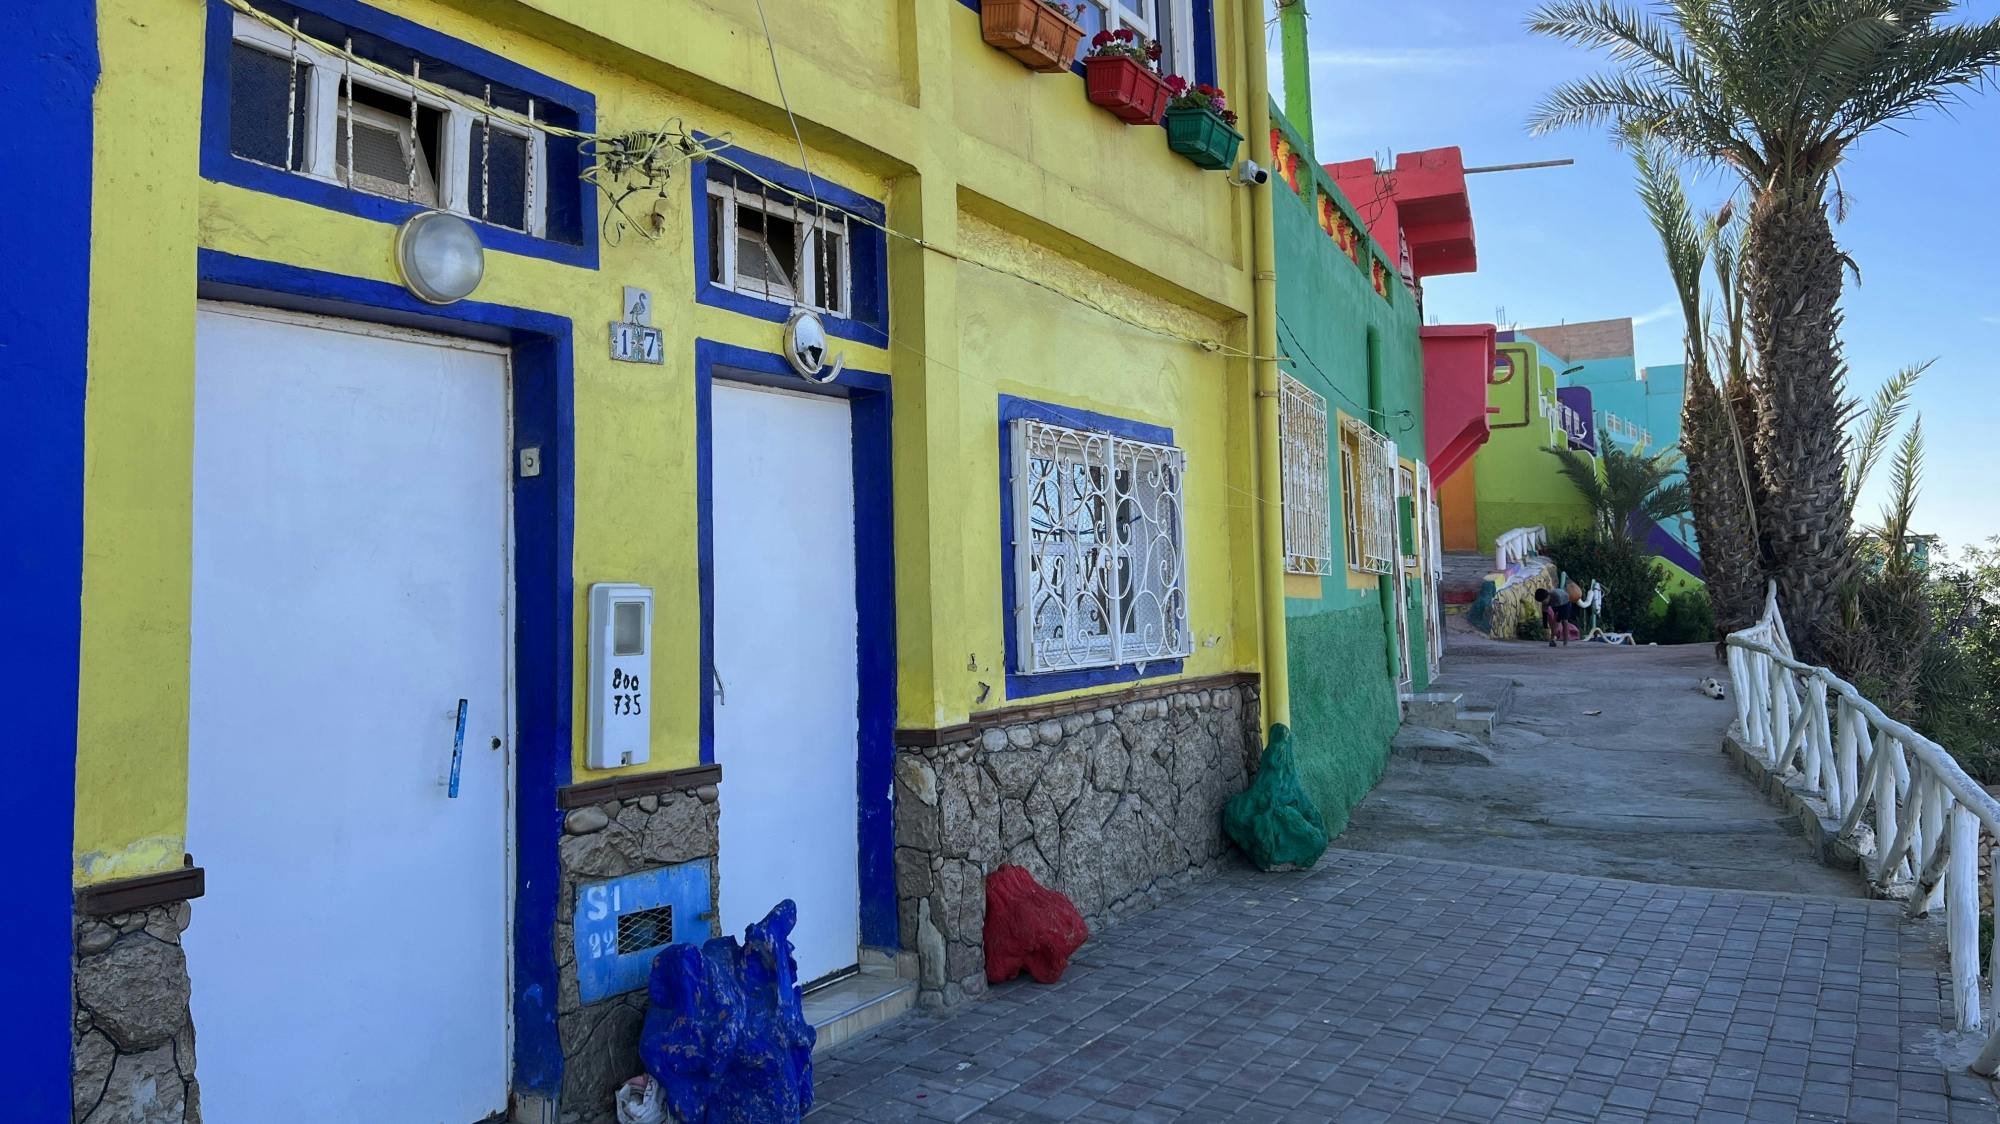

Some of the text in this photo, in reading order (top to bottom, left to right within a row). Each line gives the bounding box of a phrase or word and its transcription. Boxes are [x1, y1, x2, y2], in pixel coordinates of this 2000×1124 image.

[621, 329, 656, 358] 17
[612, 667, 640, 691] 800
[613, 693, 642, 716] 735
